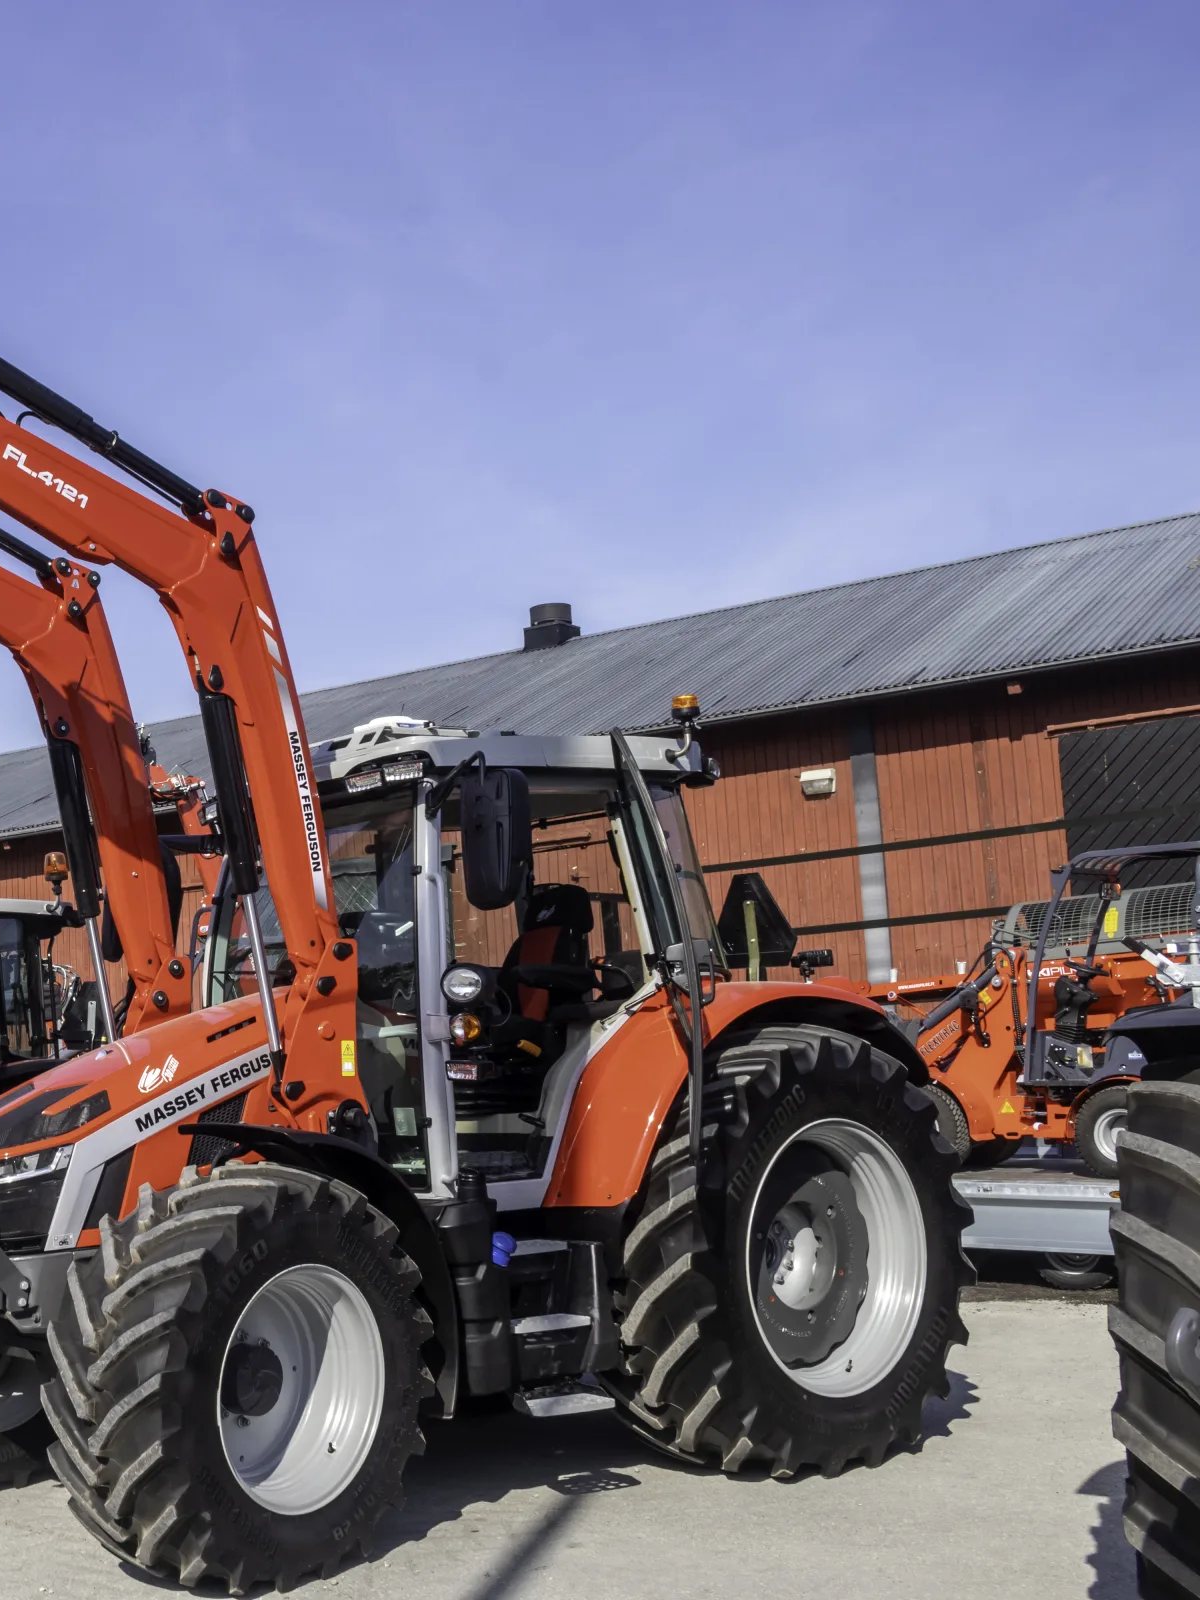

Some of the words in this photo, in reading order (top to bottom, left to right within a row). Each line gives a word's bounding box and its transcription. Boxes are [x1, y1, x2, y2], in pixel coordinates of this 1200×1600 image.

[2, 443, 88, 509] FL.4121
[289, 731, 308, 790] MASSEY
[301, 795, 322, 872] FERGUSON
[919, 1019, 961, 1057] FLEXITRAC
[135, 1083, 205, 1132] MASSEY
[210, 1053, 271, 1093] FERGUS
[726, 1083, 806, 1201] TRELLEBORG
